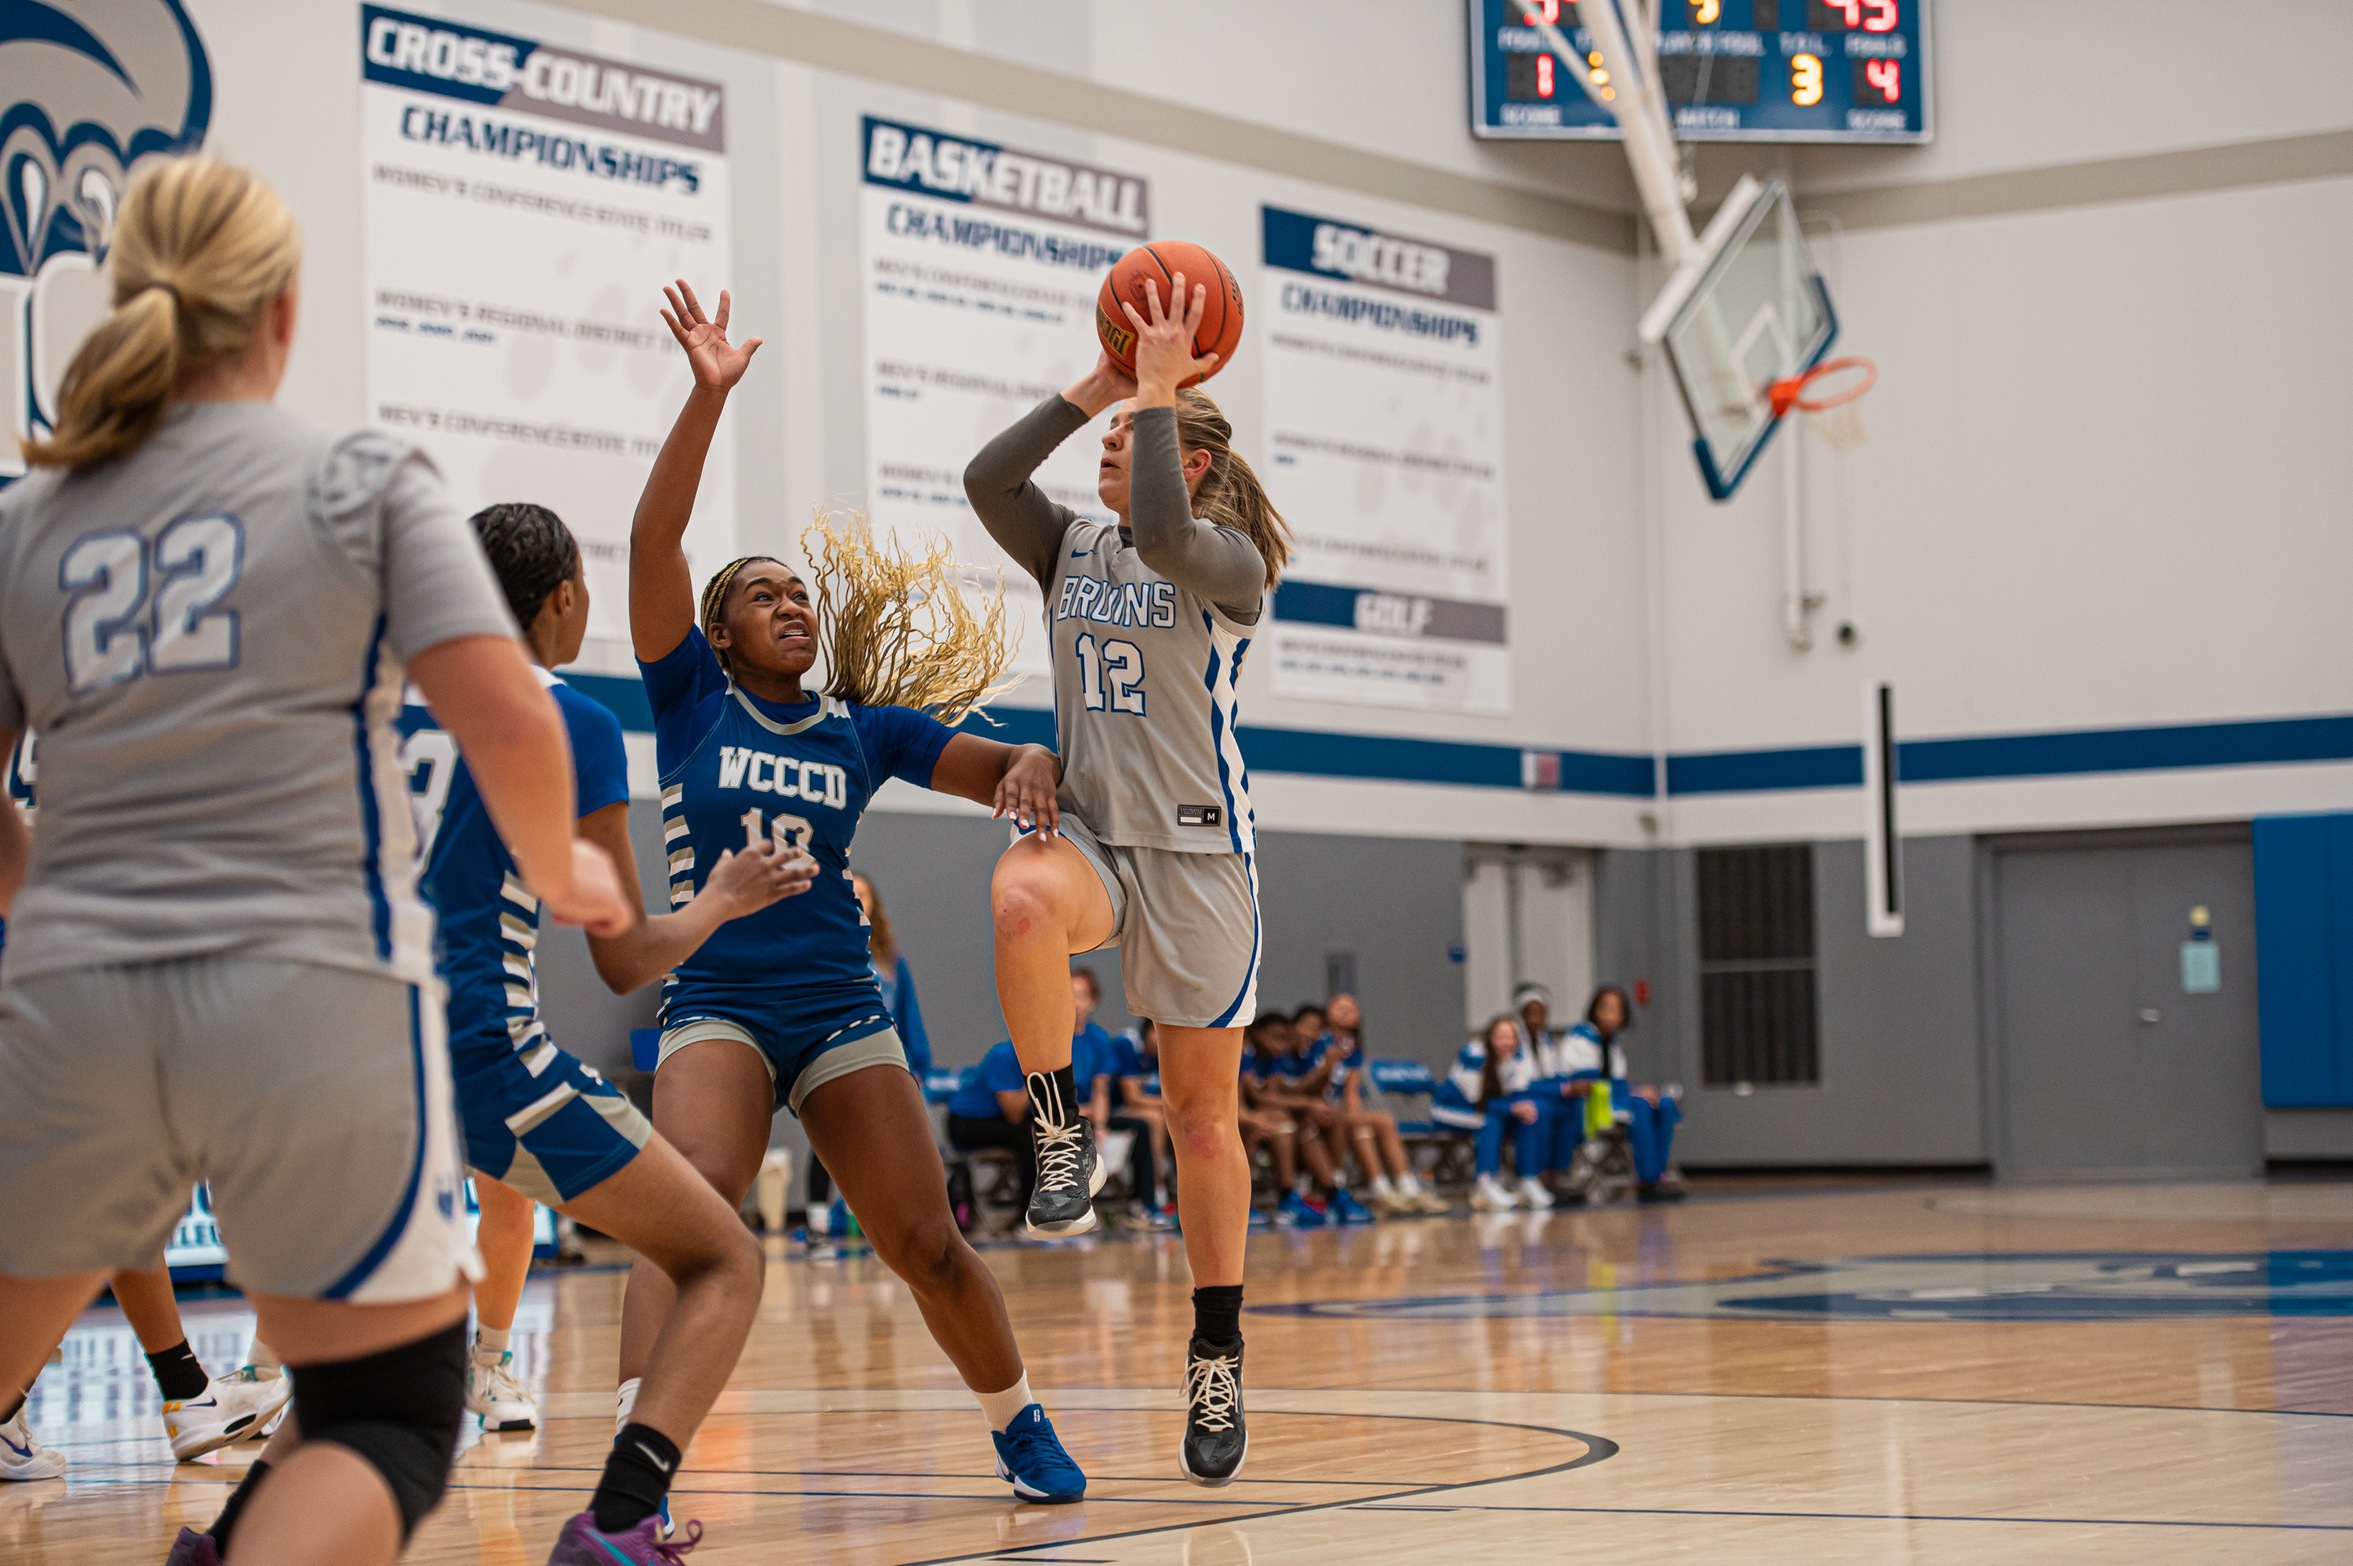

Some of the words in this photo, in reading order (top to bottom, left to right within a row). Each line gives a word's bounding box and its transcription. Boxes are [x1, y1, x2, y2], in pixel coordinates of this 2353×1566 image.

[366, 15, 722, 135] CROSS-COUNTRY
[1791, 53, 1823, 107] 3
[1866, 58, 1901, 104] 4
[399, 105, 702, 197] CHAMPIONSHIPS
[867, 124, 1147, 232] BASKETBALL
[1311, 222, 1452, 296] SOCCER
[1280, 280, 1482, 350] CHAMPIONSHIPS
[57, 510, 247, 699] 22
[1056, 574, 1177, 629] BRUINS
[1075, 632, 1146, 718] 12
[717, 745, 848, 811] WCCCD
